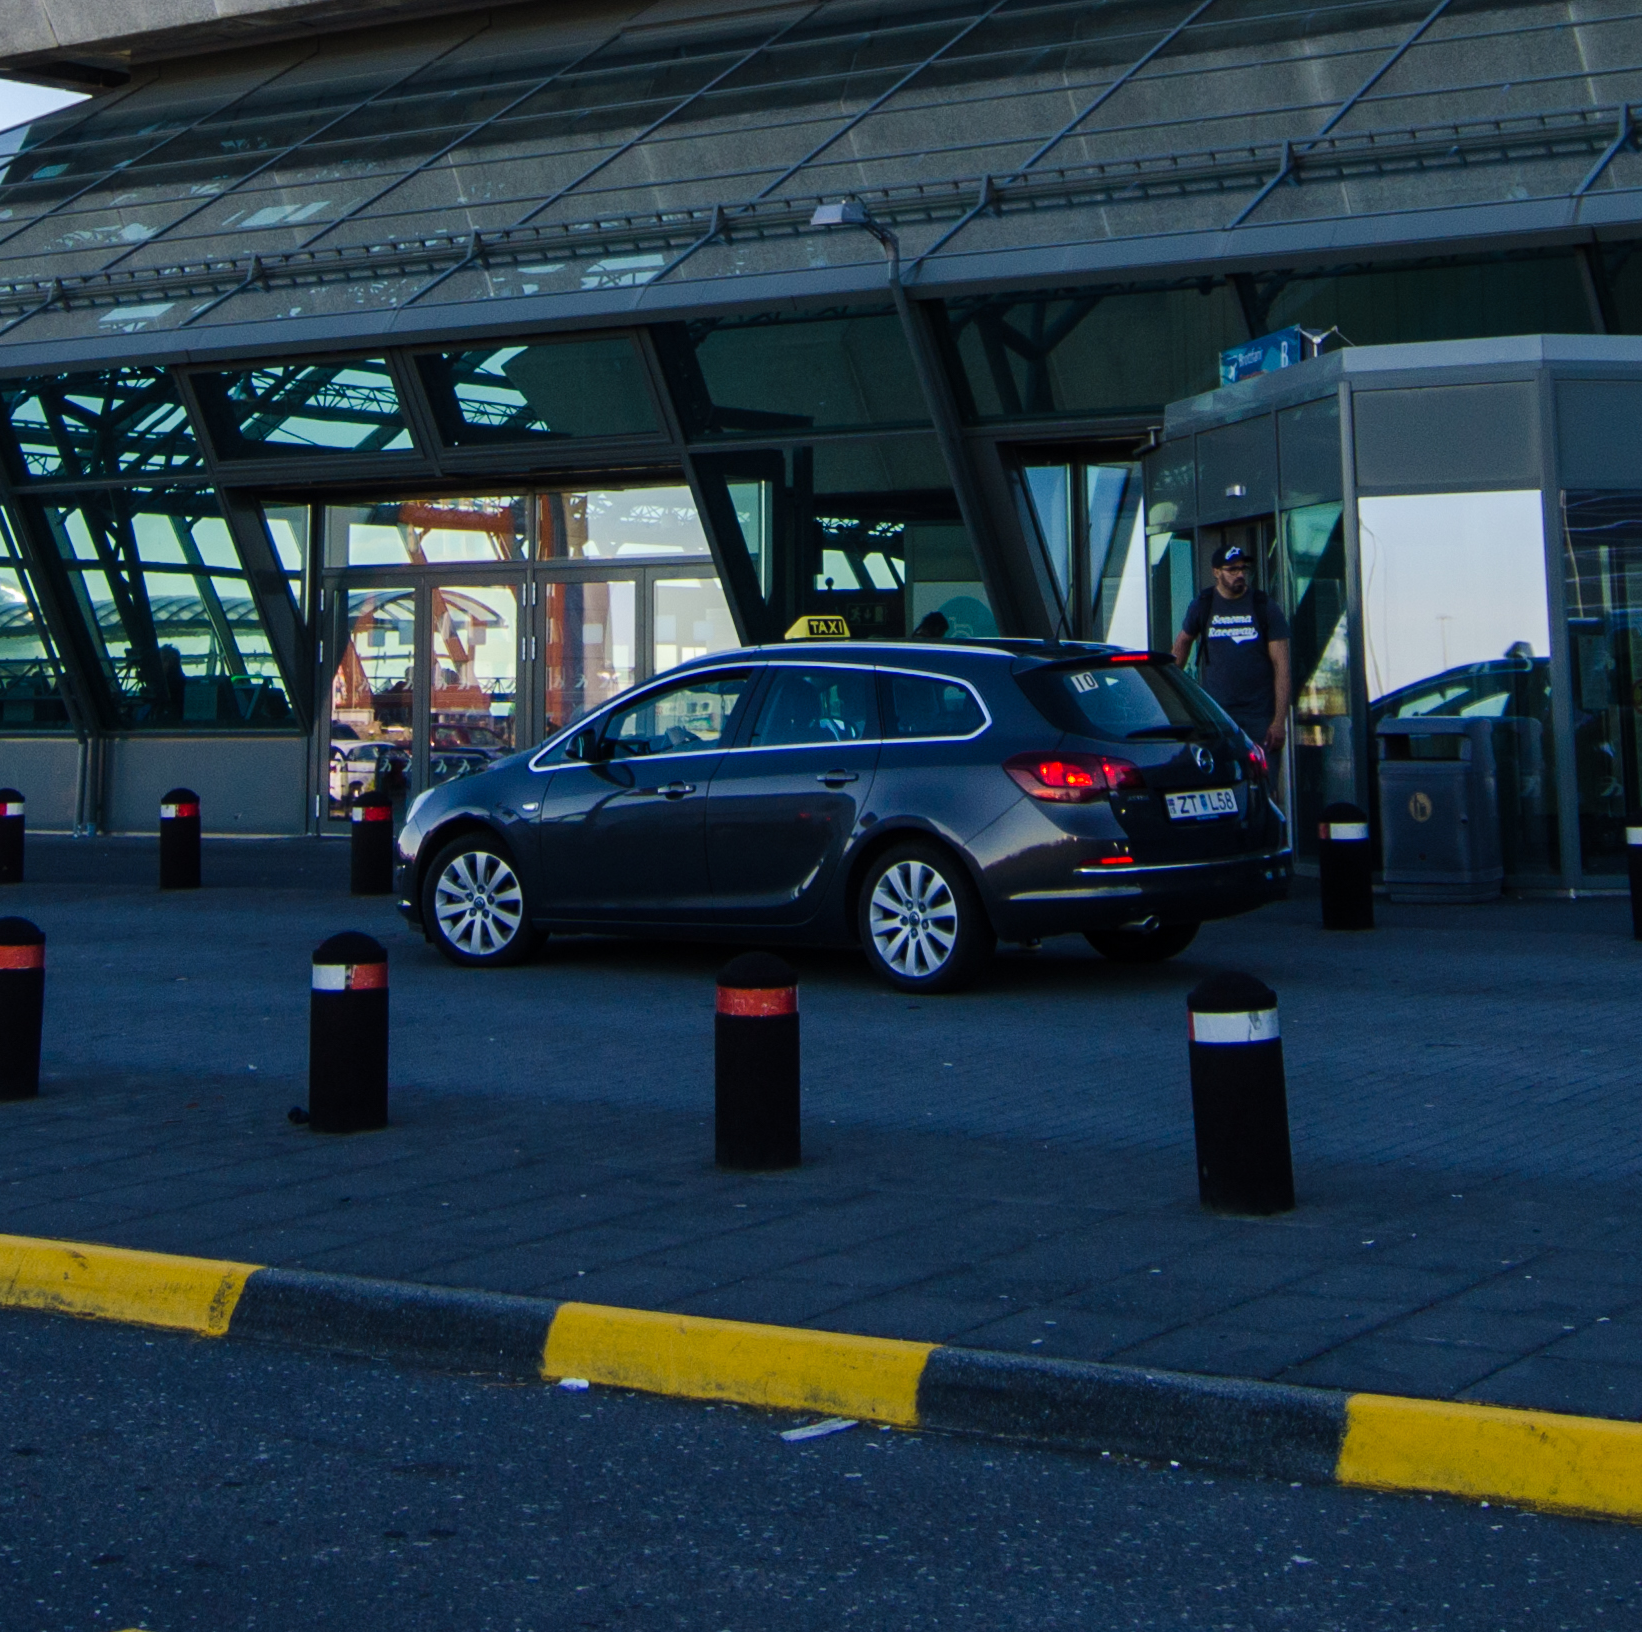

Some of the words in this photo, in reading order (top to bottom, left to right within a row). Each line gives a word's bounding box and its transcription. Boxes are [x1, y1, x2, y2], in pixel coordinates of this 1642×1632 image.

[810, 620, 843, 634] TAXI
[1211, 614, 1252, 625] Sonoma
[1208, 626, 1258, 642] Raceway
[1075, 673, 1096, 691] 10
[1176, 794, 1198, 814] ZT
[1207, 791, 1235, 811] L58
